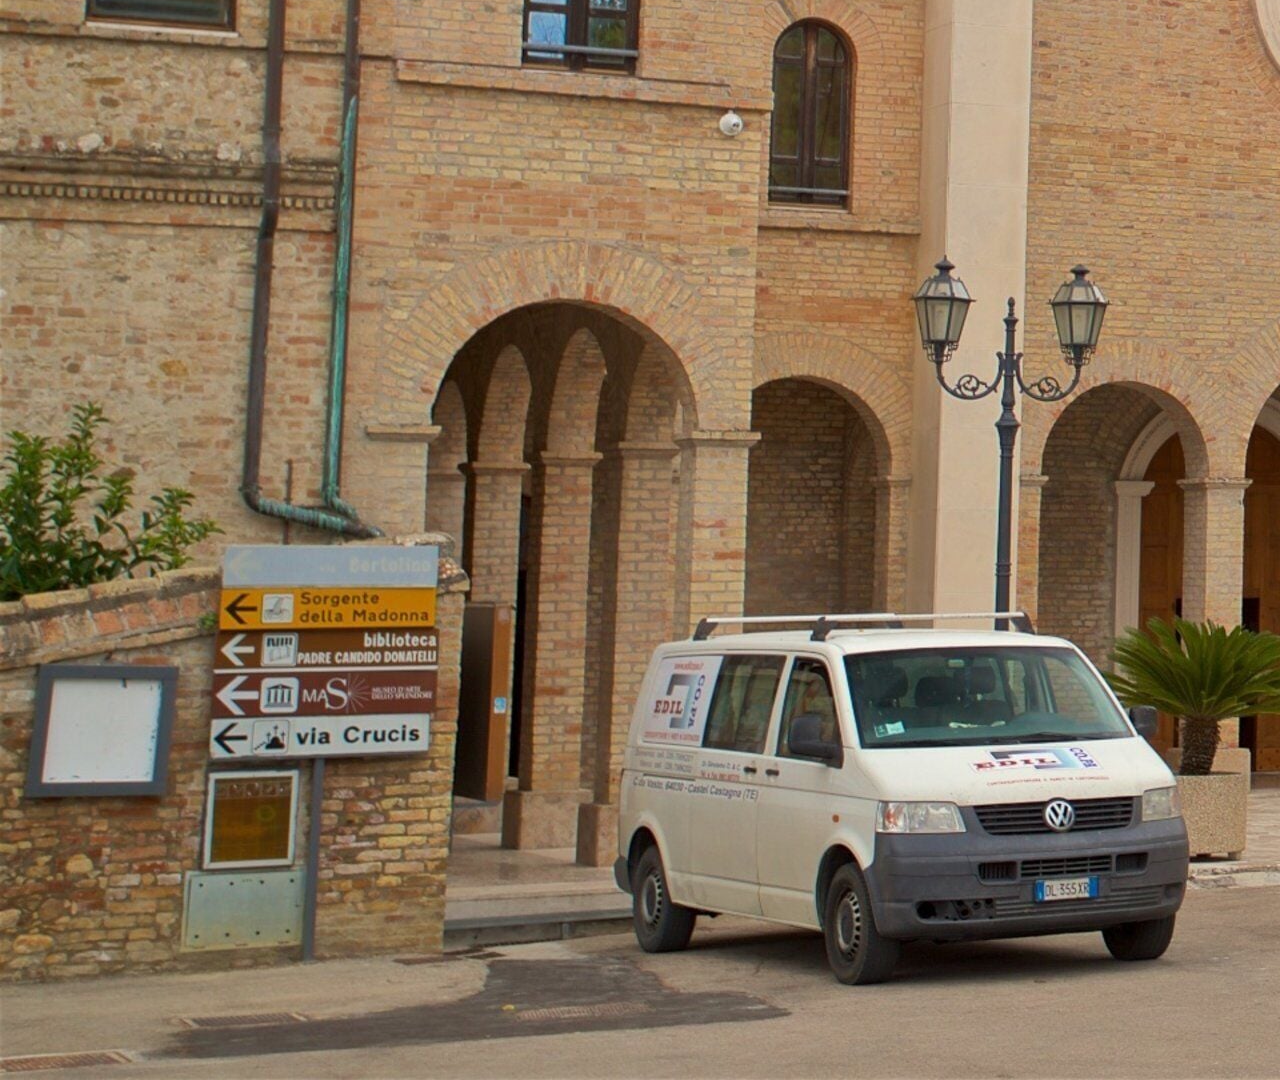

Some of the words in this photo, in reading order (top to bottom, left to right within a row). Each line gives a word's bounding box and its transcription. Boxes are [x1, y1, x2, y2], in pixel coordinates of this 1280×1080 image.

[300, 592, 380, 607] Sorgente
[300, 609, 344, 623] della
[352, 609, 429, 623] Madonna
[363, 632, 437, 648] biblioteca
[297, 651, 332, 665] PADRE
[335, 651, 382, 664] CANDIDO
[383, 650, 437, 663] DONATELLI
[654, 699, 684, 714] EDIL
[296, 727, 331, 745] via
[343, 725, 420, 744] Crucis
[973, 757, 1057, 770] EDIL
